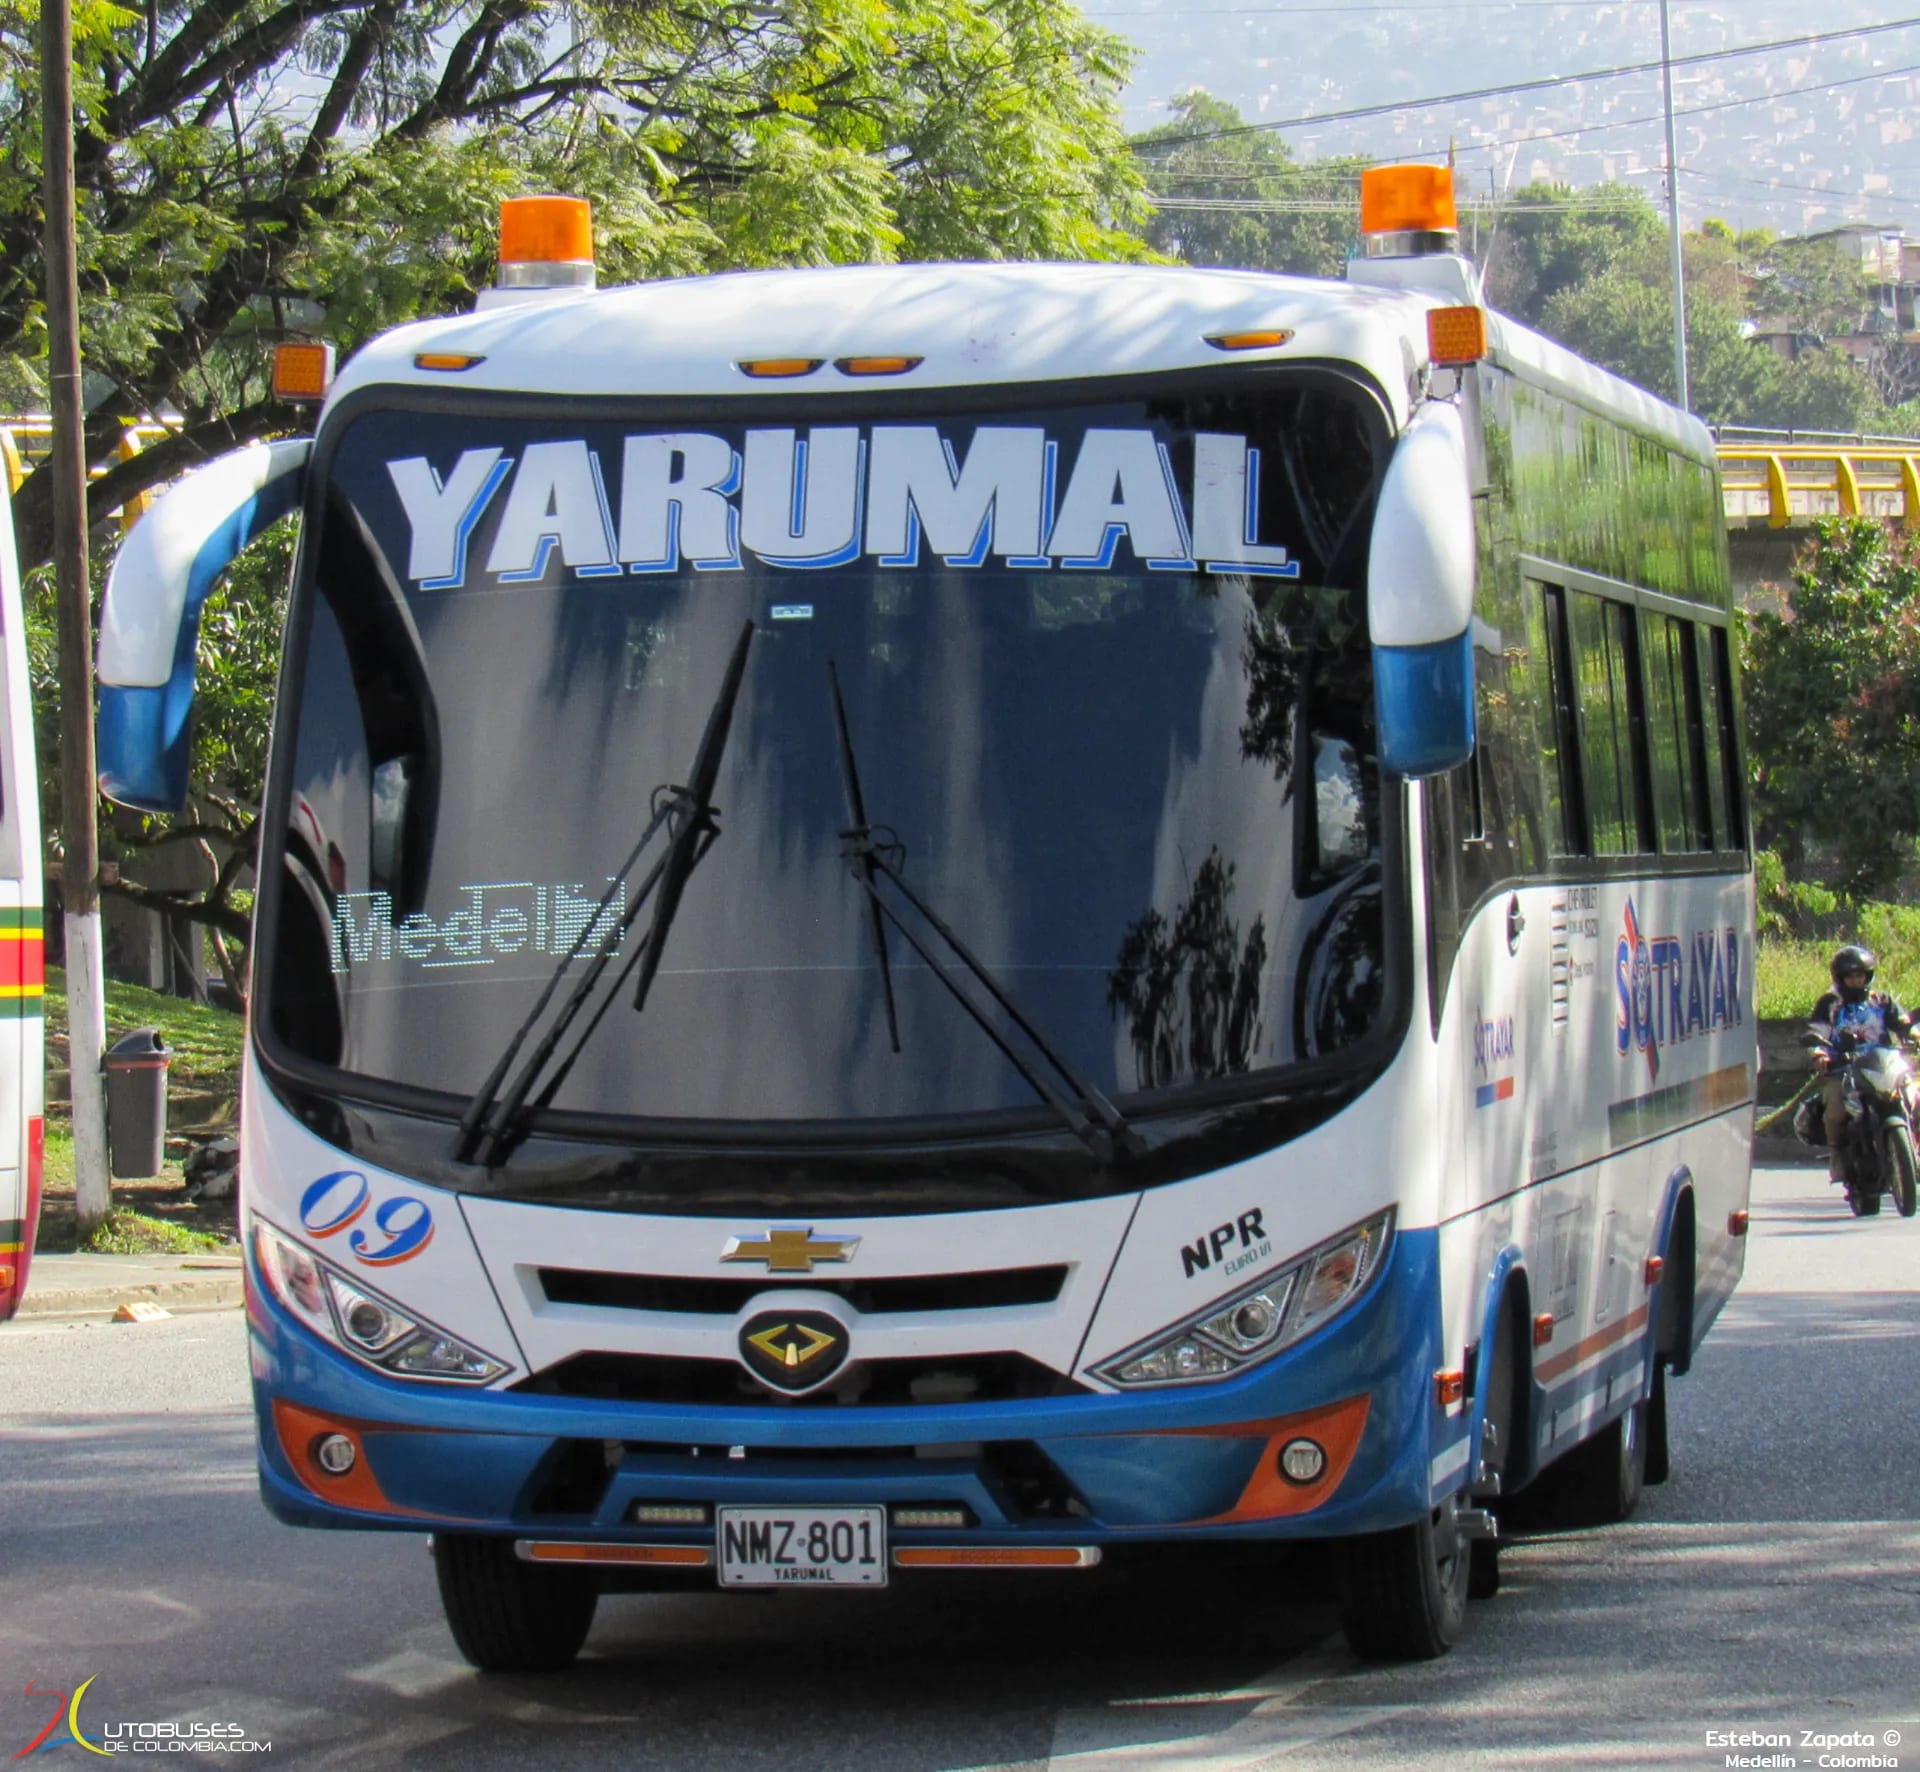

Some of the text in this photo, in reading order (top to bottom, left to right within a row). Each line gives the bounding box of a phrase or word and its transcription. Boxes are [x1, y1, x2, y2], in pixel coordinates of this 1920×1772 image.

[385, 426, 1301, 591] YARUMAL
[299, 1170, 436, 1268] 09
[1180, 1206, 1267, 1279] NPR
[1223, 1248, 1259, 1276] EURO
[773, 1567, 835, 1581] YARUMAL
